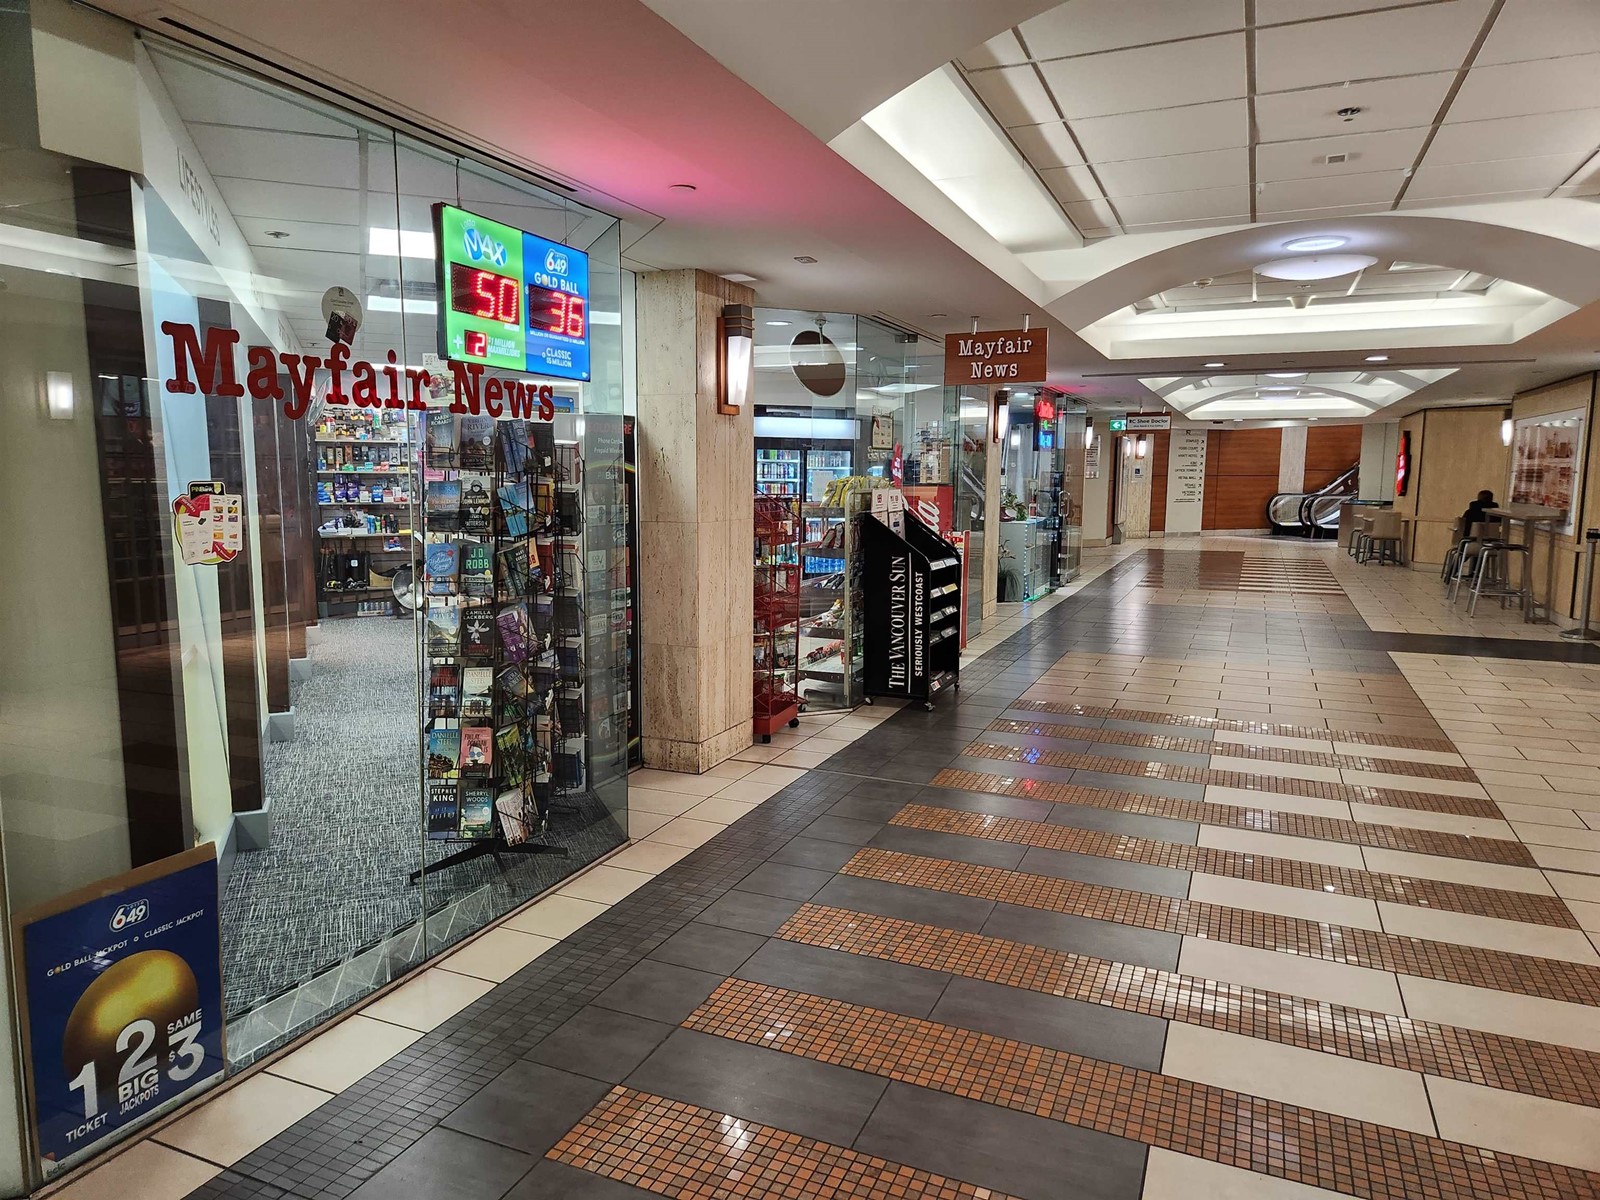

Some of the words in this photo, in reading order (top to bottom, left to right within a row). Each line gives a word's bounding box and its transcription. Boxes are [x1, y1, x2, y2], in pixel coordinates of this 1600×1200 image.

[463, 228, 506, 268] MAX
[546, 252, 566, 273] 649
[477, 271, 518, 322] 50
[534, 272, 558, 288] GOLD
[560, 278, 579, 296] BALL
[550, 292, 584, 337] 36
[474, 334, 486, 356] 2
[546, 348, 572, 360] CLASSIC
[958, 336, 1032, 359] Mayfair
[161, 320, 431, 420] Mayfair
[447, 360, 554, 422] News
[552, 359, 572, 368] MILLION
[970, 362, 1018, 378] News
[466, 558, 490, 569] ROBB
[888, 556, 906, 582] SUN
[914, 572, 924, 626] WESTCOAST
[890, 585, 906, 662] VANCOUVER
[914, 628, 923, 677] SERIOUSLY
[888, 662, 906, 689] THE
[112, 904, 146, 930] 649
[46, 962, 71, 977] GOLD
[74, 955, 92, 966] BALL
[94, 939, 128, 959] JACKPOT
[144, 922, 174, 938] CLASSIC
[176, 908, 204, 927] JACKPOT
[167, 1008, 203, 1034] SAME
[116, 1019, 158, 1084] 2
[68, 1060, 98, 1120] 1
[118, 1068, 159, 1104] BIG
[120, 1084, 160, 1116] JACKPOTS
[66, 1112, 108, 1144] TICKET
